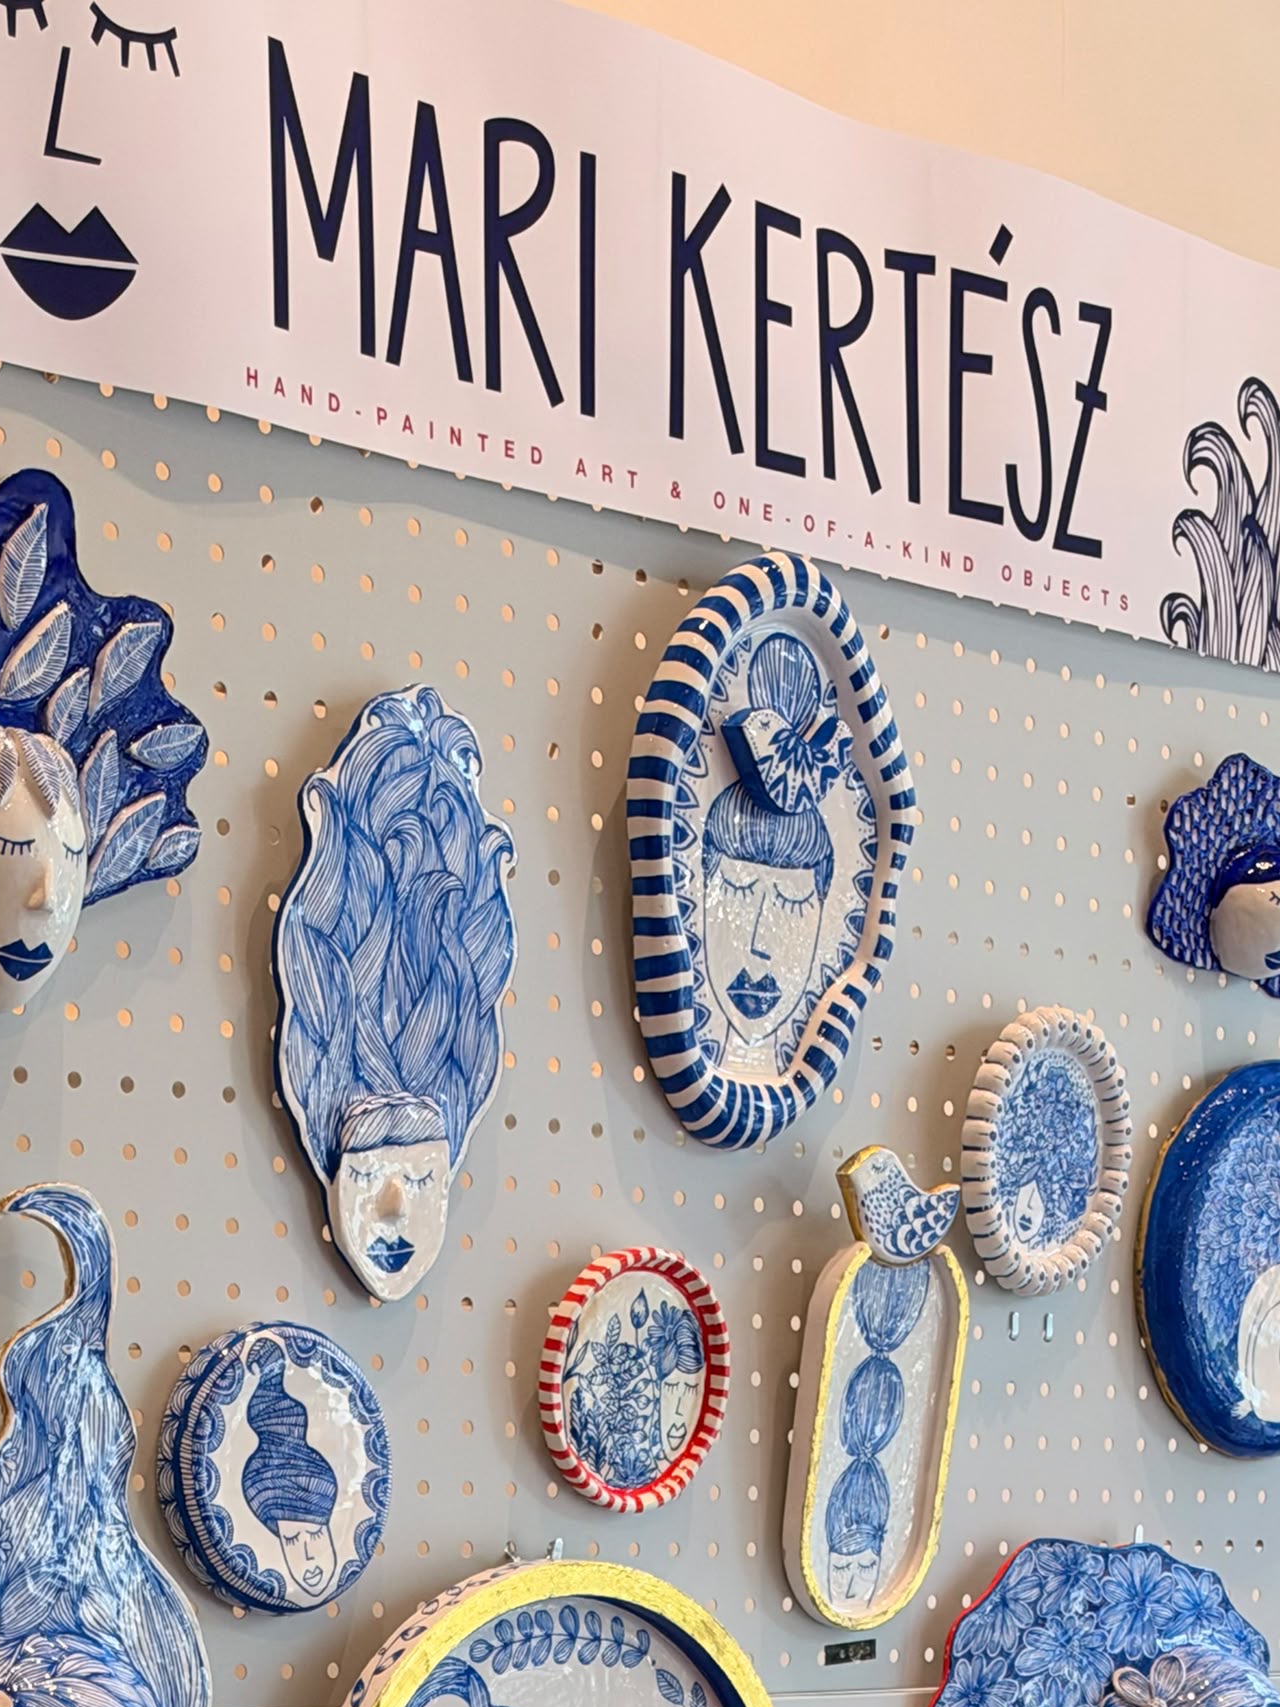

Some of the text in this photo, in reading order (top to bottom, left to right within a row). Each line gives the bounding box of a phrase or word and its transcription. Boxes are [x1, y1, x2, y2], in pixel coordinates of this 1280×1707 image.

[246, 366, 1129, 611] HAND-PAINTED ART & ONE-OF-A-KIND OBJECTS
[269, 36, 1112, 559] MARI KERTÉSZ
